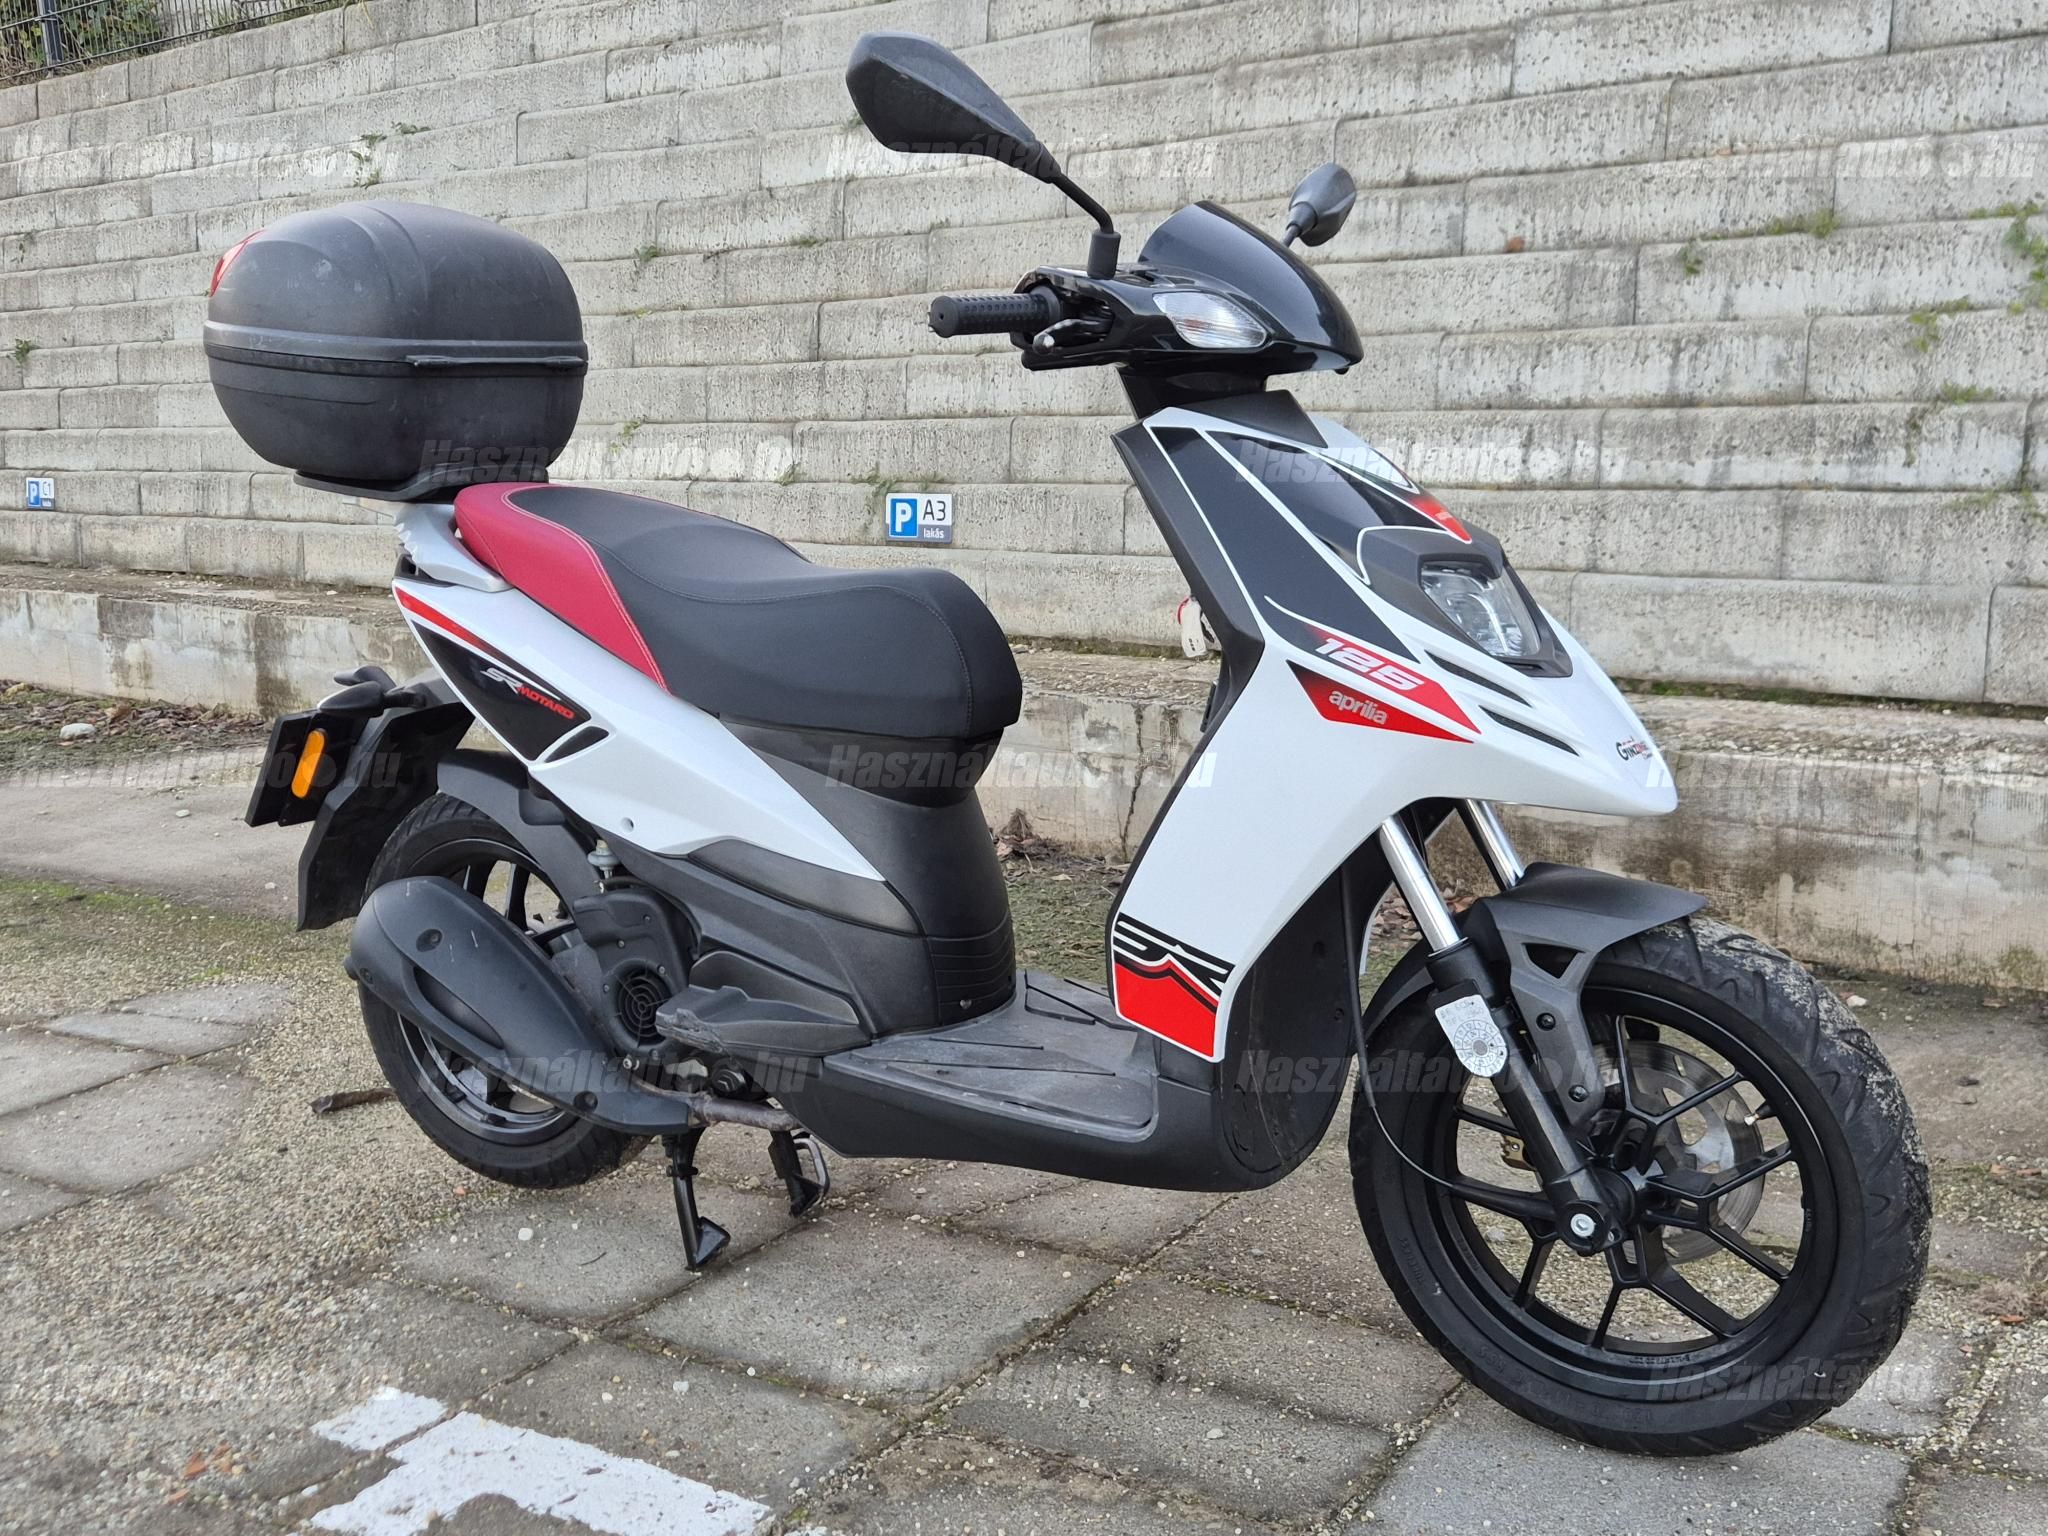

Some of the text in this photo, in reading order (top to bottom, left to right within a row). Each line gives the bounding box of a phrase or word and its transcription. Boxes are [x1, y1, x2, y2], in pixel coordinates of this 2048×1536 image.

[895, 502, 912, 532] P
[922, 499, 946, 521] A3
[923, 527, 945, 539] lakás
[1315, 638, 1424, 691] 125
[480, 667, 574, 719] SR MOTARD
[1328, 690, 1388, 725] aprilia
